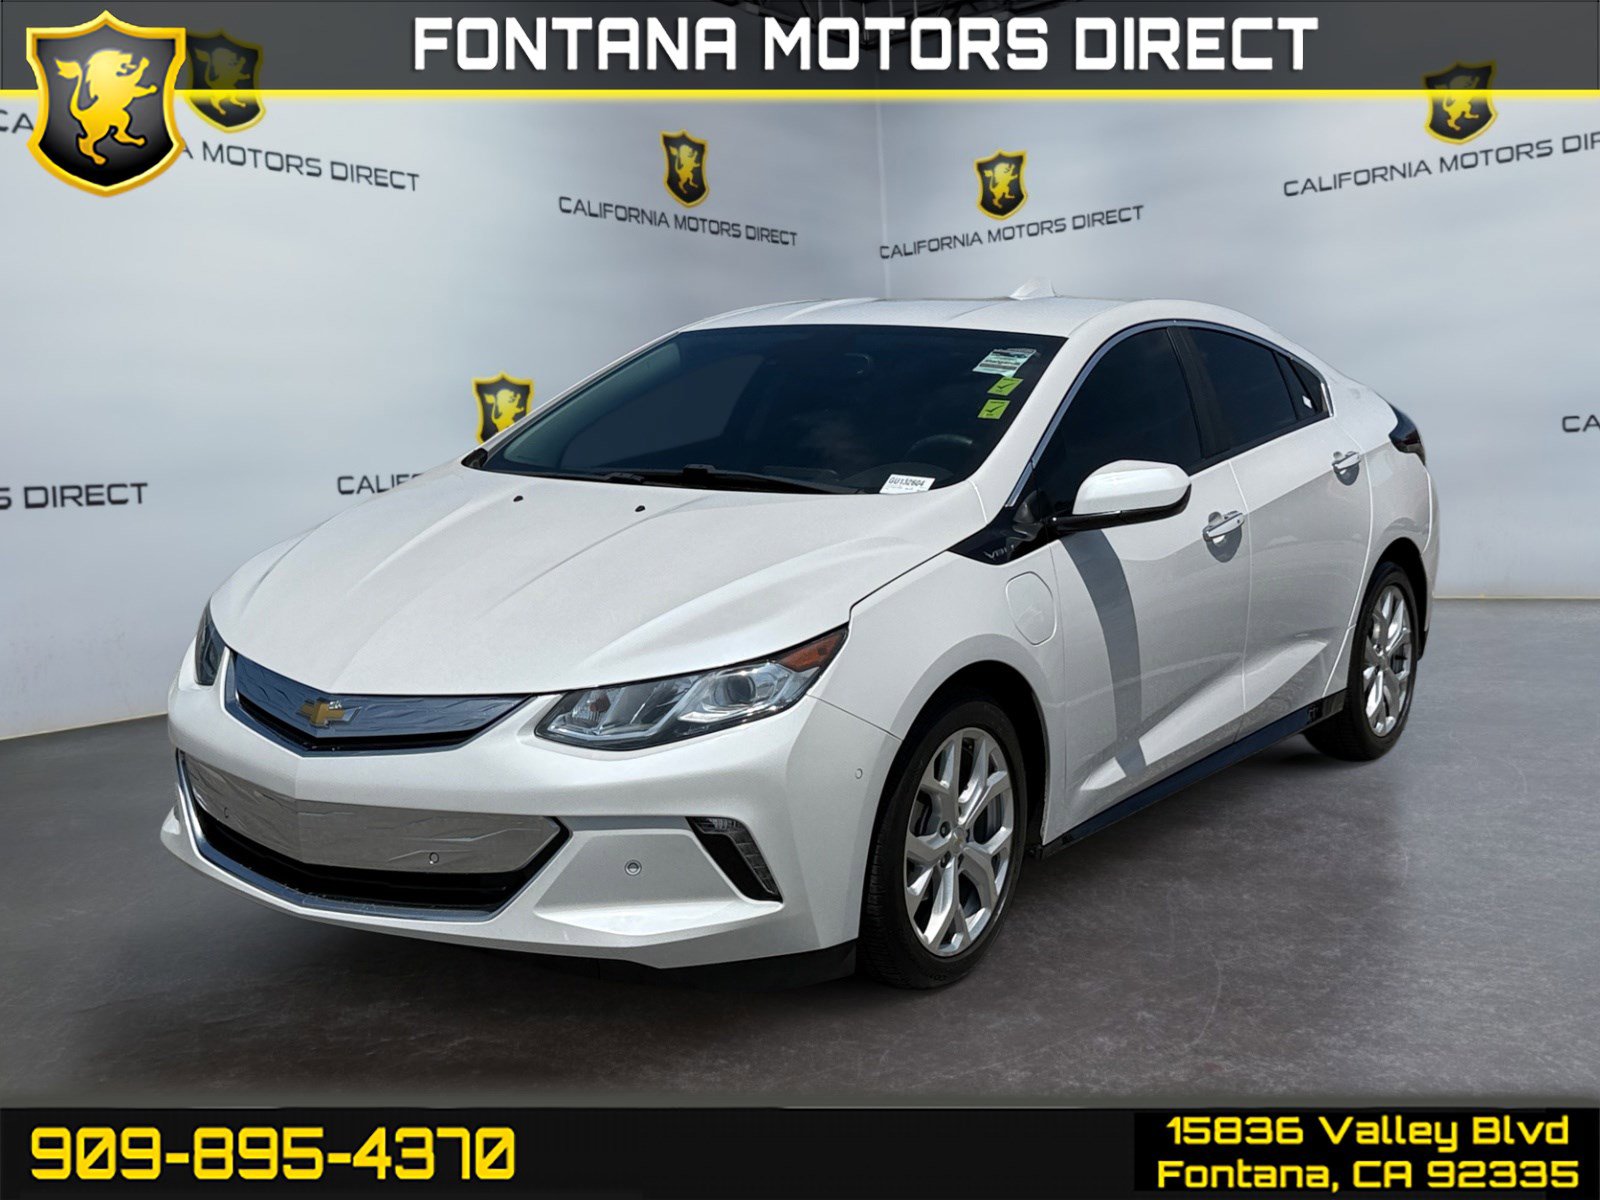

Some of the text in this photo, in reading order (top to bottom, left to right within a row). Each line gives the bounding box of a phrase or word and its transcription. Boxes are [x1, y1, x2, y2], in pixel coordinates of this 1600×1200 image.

[202, 141, 420, 192] MOTORS DIRECT
[1283, 159, 1433, 198] CALIFORNIA
[1439, 138, 1554, 174] MOTORS
[558, 196, 798, 247] CALIFORNIA MOTORS DIRECT
[879, 205, 1145, 260] CALIFORNIA MOTORS DIRECT
[23, 482, 148, 509] DIRECT
